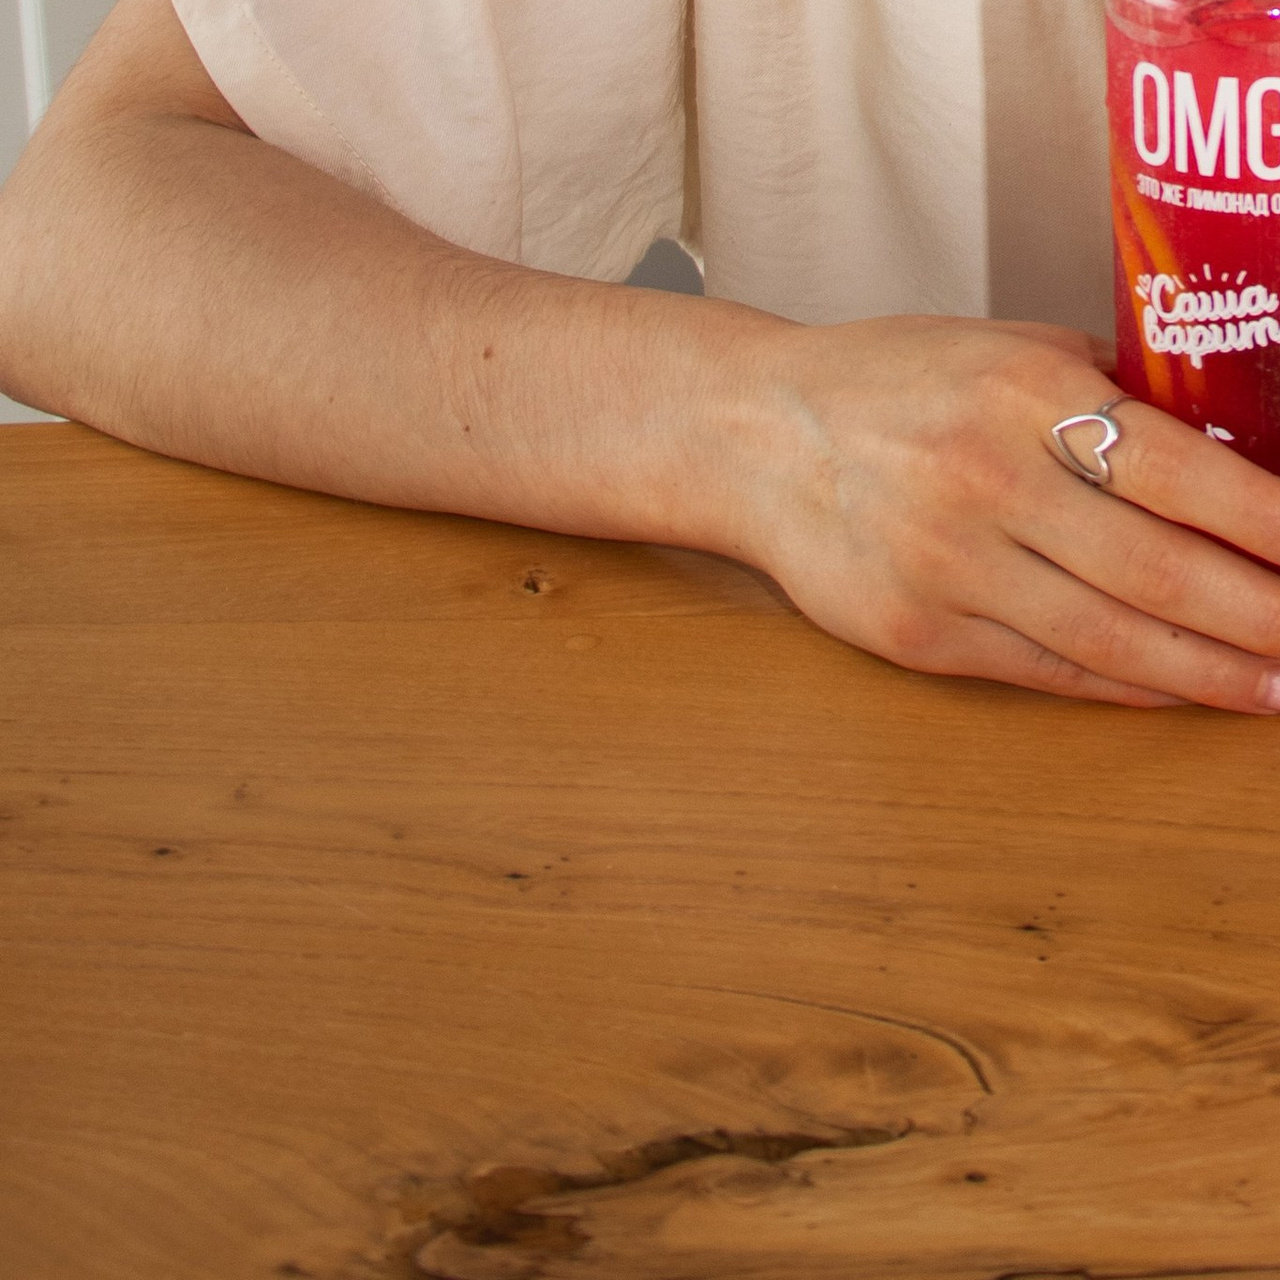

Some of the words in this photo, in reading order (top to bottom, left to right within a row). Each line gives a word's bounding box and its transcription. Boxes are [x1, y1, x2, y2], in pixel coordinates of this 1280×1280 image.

[1136, 172, 1160, 200] ЭТО
[1160, 180, 1185, 207] ЖЕ
[1186, 187, 1271, 217] ЛИМОНАД
[1150, 273, 1280, 323] Саша
